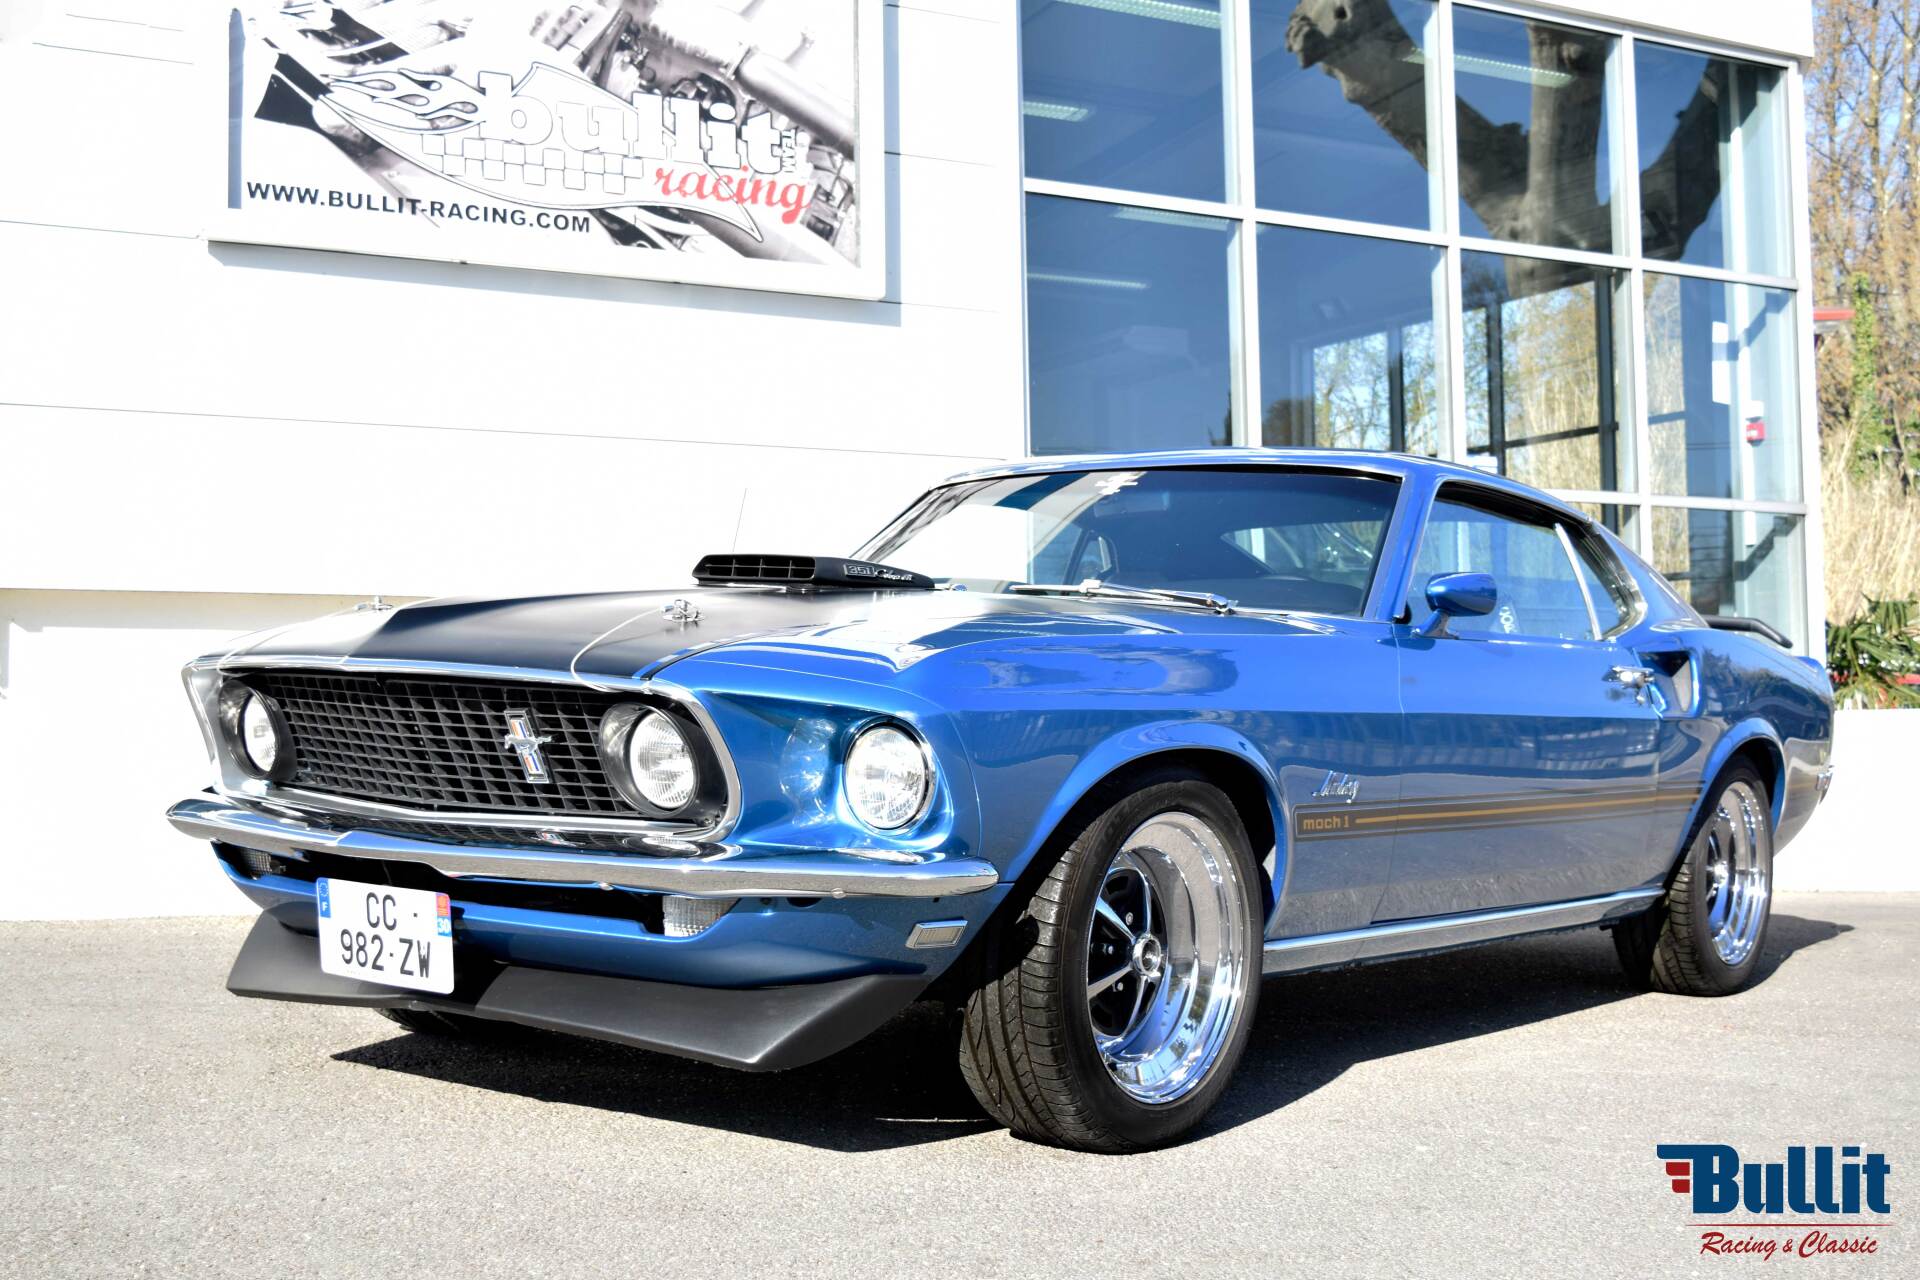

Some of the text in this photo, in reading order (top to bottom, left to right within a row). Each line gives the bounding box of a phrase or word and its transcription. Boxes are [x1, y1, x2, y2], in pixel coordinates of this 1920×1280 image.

[478, 70, 783, 175] bullit
[781, 129, 797, 174] TEAM
[246, 181, 591, 233] WWW.BULLIT-RACING.COM
[655, 164, 812, 225] racing
[848, 565, 871, 576] 351
[1343, 815, 1350, 828] 1
[321, 901, 328, 912] F
[437, 917, 450, 933] 30
